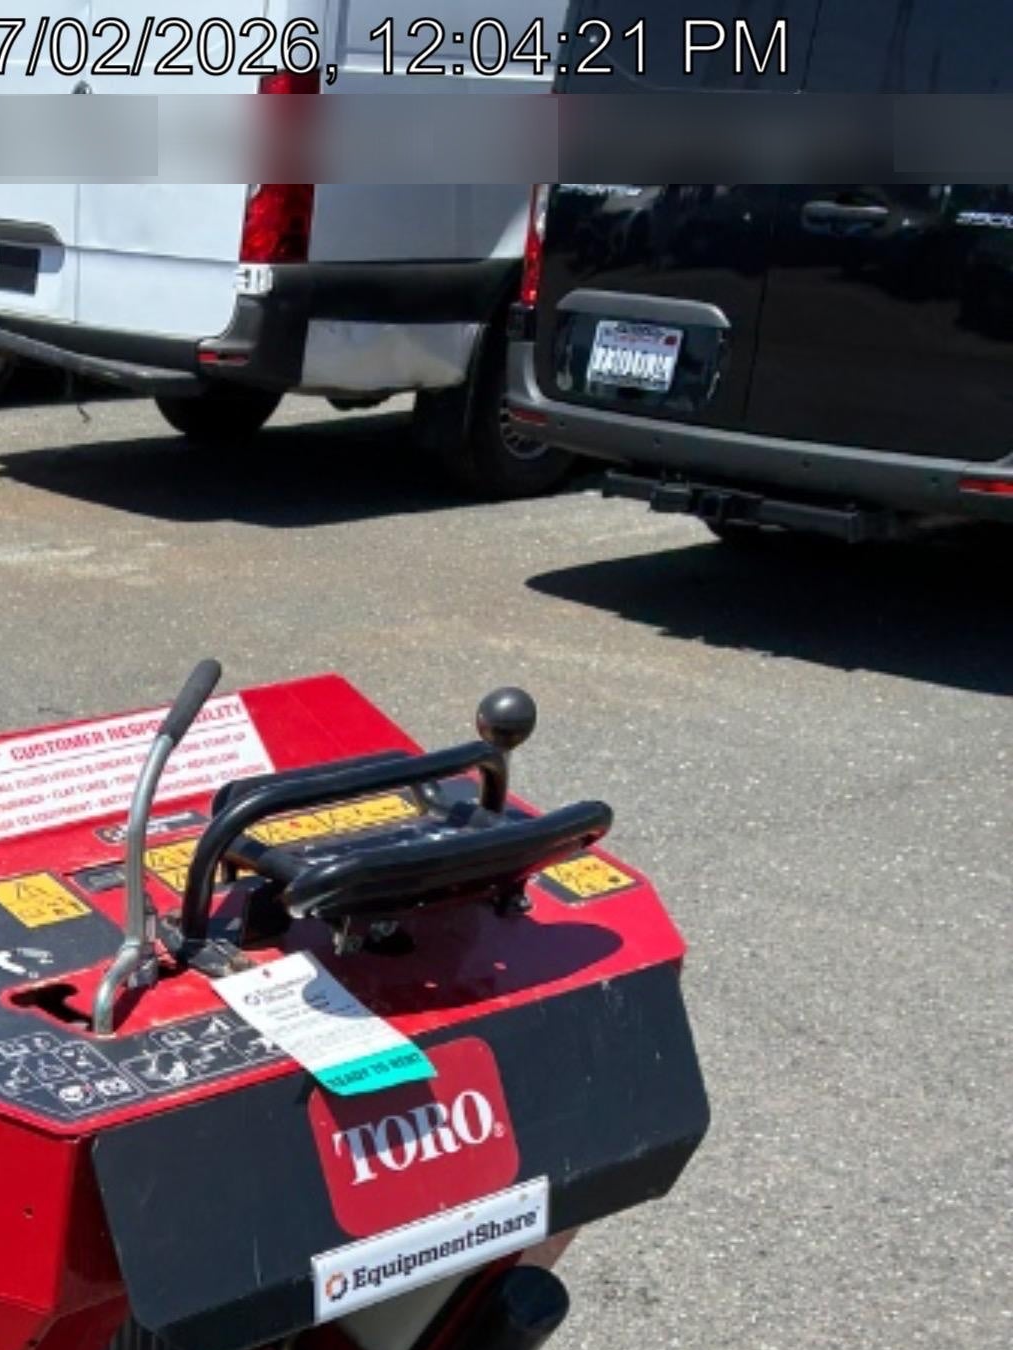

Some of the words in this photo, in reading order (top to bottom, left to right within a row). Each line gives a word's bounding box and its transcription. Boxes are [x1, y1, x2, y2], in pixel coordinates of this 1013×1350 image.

[8, 729, 107, 761] CUSTOMER
[104, 702, 243, 742] RESPOBILITY
[332, 1089, 494, 1186] TORO
[352, 1208, 538, 1291] EquipmentShare
